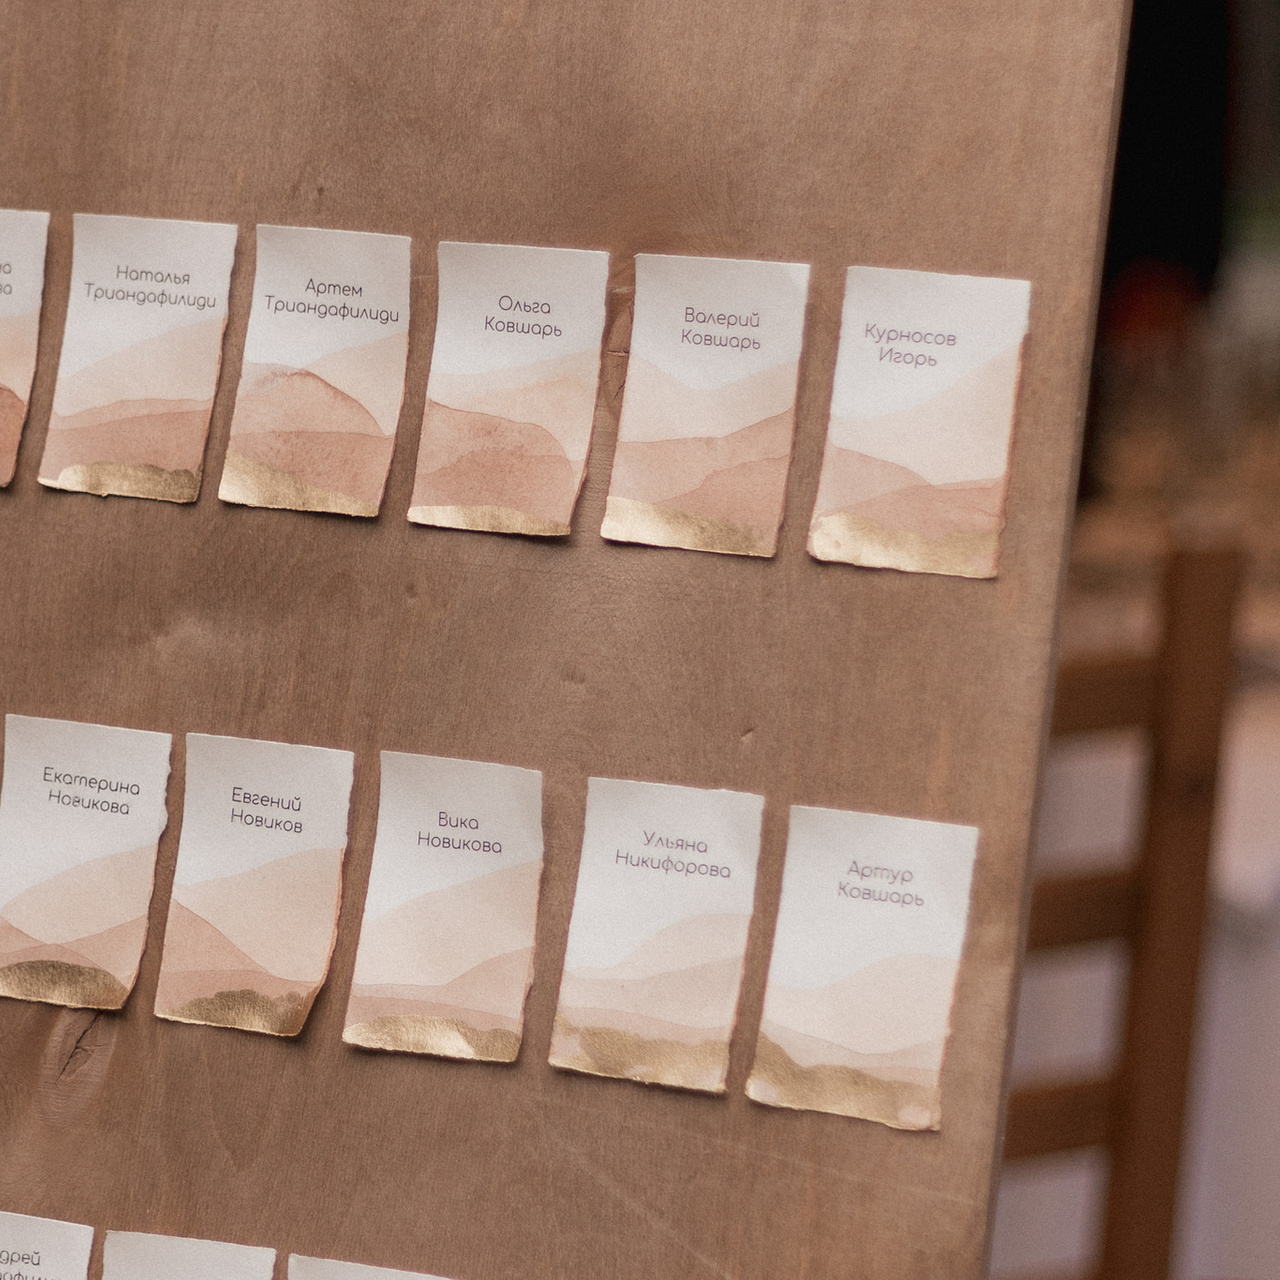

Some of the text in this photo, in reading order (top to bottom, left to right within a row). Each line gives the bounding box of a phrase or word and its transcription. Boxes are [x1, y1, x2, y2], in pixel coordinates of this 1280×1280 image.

[115, 265, 191, 286] Наталья
[304, 277, 364, 298] Артем
[84, 281, 217, 312] Триандафилиди
[497, 294, 552, 315] Ольга
[265, 294, 400, 326] Триандафилиди
[684, 305, 761, 329] Валерий
[484, 315, 563, 339] Ковшарь
[864, 322, 958, 347] Курносов
[681, 328, 762, 352] Ковшарь
[878, 347, 938, 369] Игорь
[42, 765, 141, 797] Екатерина
[48, 790, 130, 816] Новикова
[231, 785, 302, 813] Евгений
[230, 808, 304, 835] Новиков
[437, 810, 480, 831] Вика
[417, 831, 503, 855] Новикова
[643, 830, 709, 854] Ульяна
[614, 849, 732, 880] Никифорова
[846, 859, 914, 886] Артур
[837, 881, 925, 908] Ковшарь
